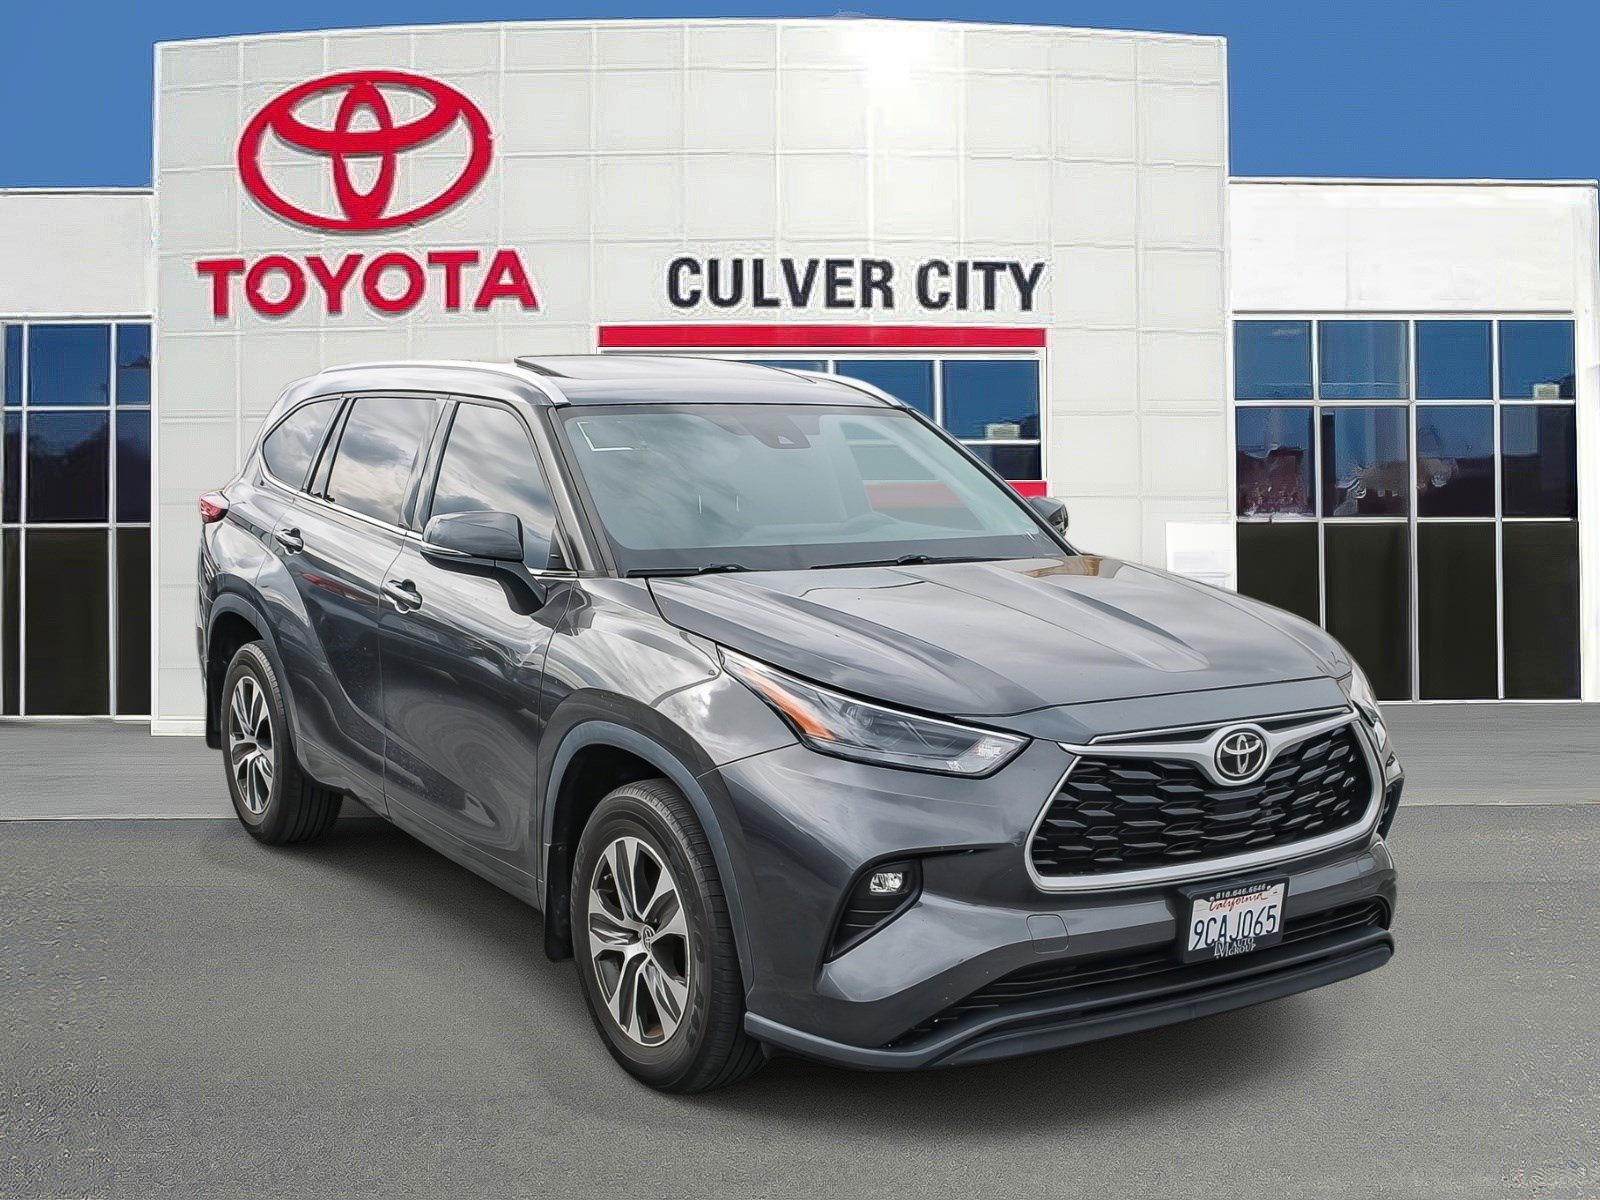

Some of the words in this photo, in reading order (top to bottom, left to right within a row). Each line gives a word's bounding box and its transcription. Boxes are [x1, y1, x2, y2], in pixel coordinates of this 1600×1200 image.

[197, 250, 538, 317] TOYOTA
[668, 257, 895, 309] CULVER
[916, 259, 1045, 311] CITY
[1209, 893, 1268, 912] California
[1193, 904, 1278, 951] 9CAJ065
[1231, 937, 1254, 950] AUTO
[1228, 943, 1257, 956] GROUP
